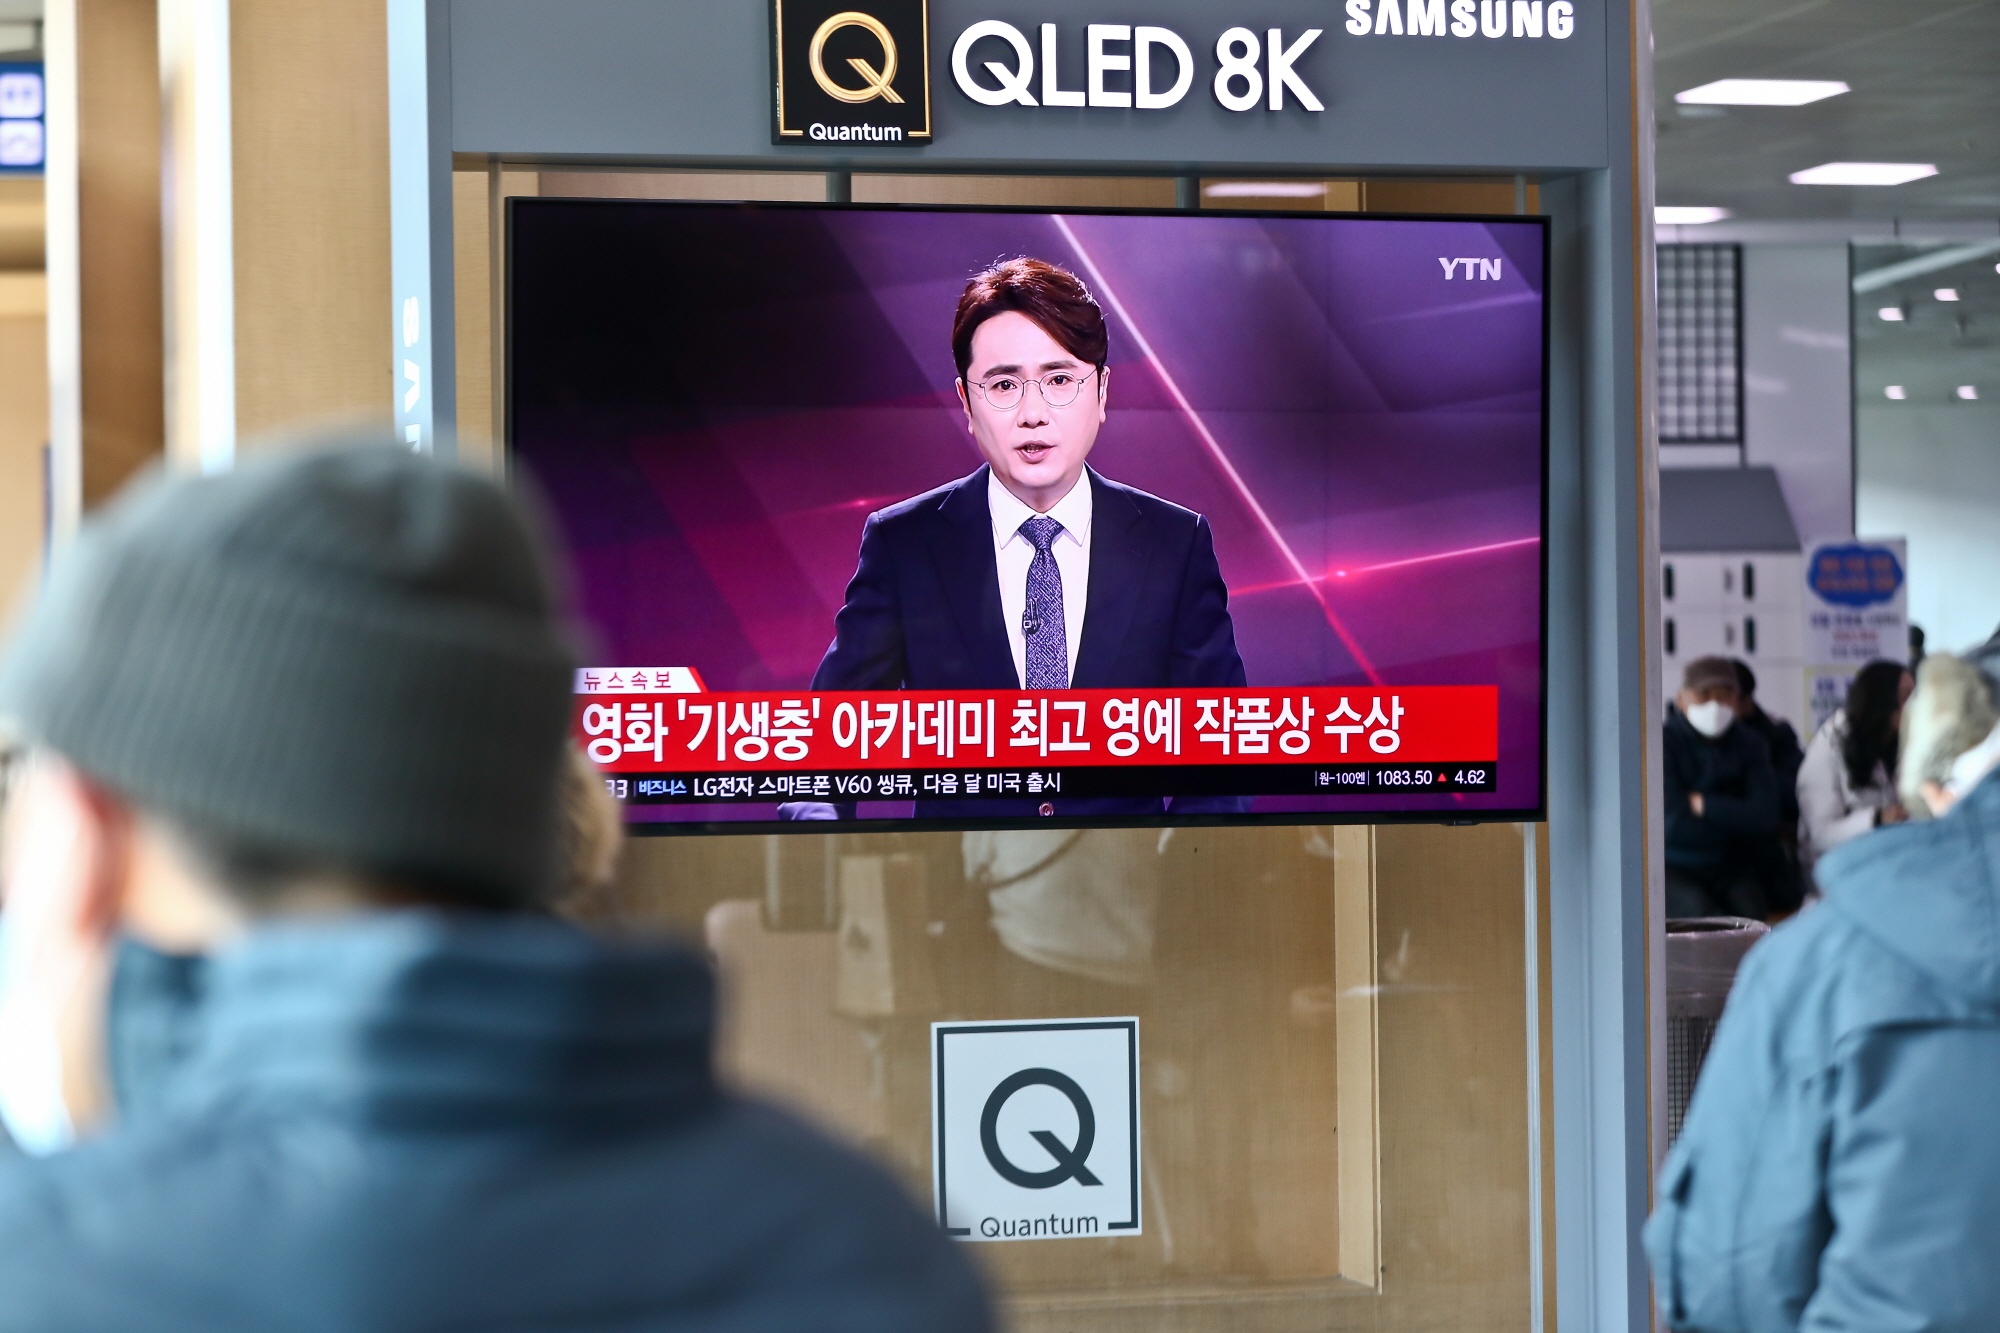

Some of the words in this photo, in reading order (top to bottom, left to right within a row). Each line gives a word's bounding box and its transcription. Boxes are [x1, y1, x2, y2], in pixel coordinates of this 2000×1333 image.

[1345, 0, 1574, 39] SAMSUNG
[808, 11, 906, 104] Q
[951, 19, 1194, 110] QLED
[1212, 27, 1325, 113] 8K
[809, 122, 902, 141] Quantum
[1438, 257, 1502, 280] YTN
[582, 702, 669, 764] 영화
[677, 698, 821, 763] '기생충'
[831, 699, 995, 760] 아카데미
[1009, 699, 1091, 757] 최고
[1102, 697, 1182, 757] 영예
[1193, 696, 1315, 756] 작품상
[1324, 695, 1405, 755] 수상
[638, 779, 688, 796] 비즈니스
[693, 776, 755, 797] LG전자
[757, 775, 831, 797] 스마트폰
[834, 774, 872, 794] V60
[876, 774, 918, 796] 씽큐,
[923, 773, 959, 794] 다음
[964, 772, 982, 794] 달
[986, 772, 1022, 793] 미국
[1026, 772, 1061, 793] 출시
[1375, 769, 1433, 786] 1083.50
[1454, 769, 1486, 785] 4.62
[979, 1067, 1104, 1189] Q
[980, 1214, 1099, 1238] Quantum
